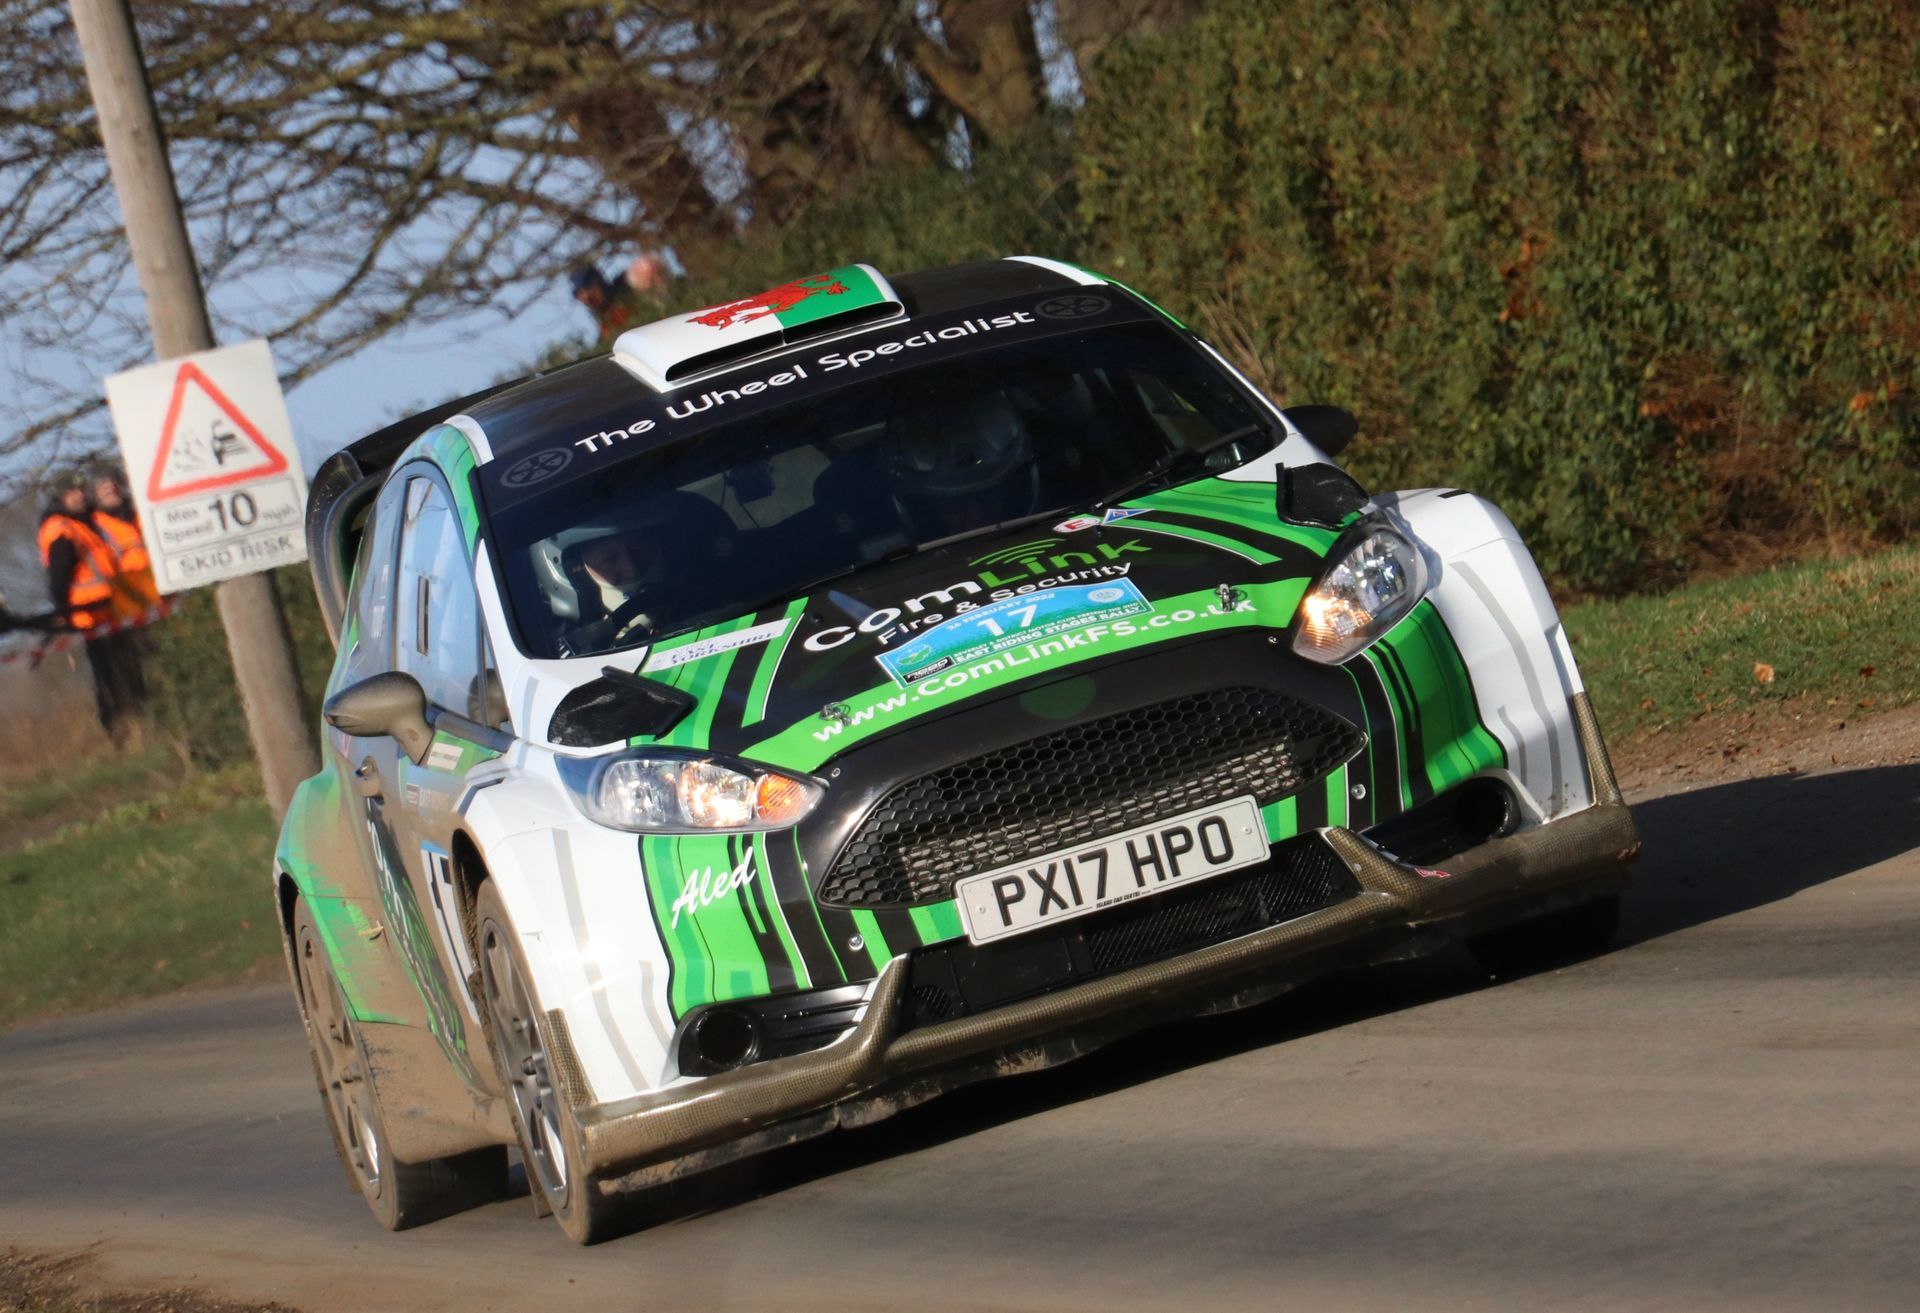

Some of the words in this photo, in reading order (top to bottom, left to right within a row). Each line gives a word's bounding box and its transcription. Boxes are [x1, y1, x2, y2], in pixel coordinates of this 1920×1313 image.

[574, 417, 657, 453] The
[666, 365, 808, 419] Wheel
[817, 311, 1036, 372] Specialist
[208, 491, 258, 531] 10
[180, 549, 232, 573] SKID
[241, 536, 294, 561] RISK
[804, 539, 1152, 651] ComLink
[877, 613, 944, 646] Fire
[956, 601, 981, 613] &
[990, 562, 1131, 602] Security
[962, 600, 1022, 623] FEBRUARY
[976, 604, 1037, 637] 17
[956, 645, 991, 662] EAST
[992, 630, 1043, 651] RIDING
[1045, 615, 1098, 635] STAGES
[1099, 605, 1141, 621] RALLY
[996, 630, 1027, 643] DISTRICT
[671, 846, 757, 929] Aled
[992, 847, 1109, 927] PX17
[1126, 815, 1234, 888] HPO
